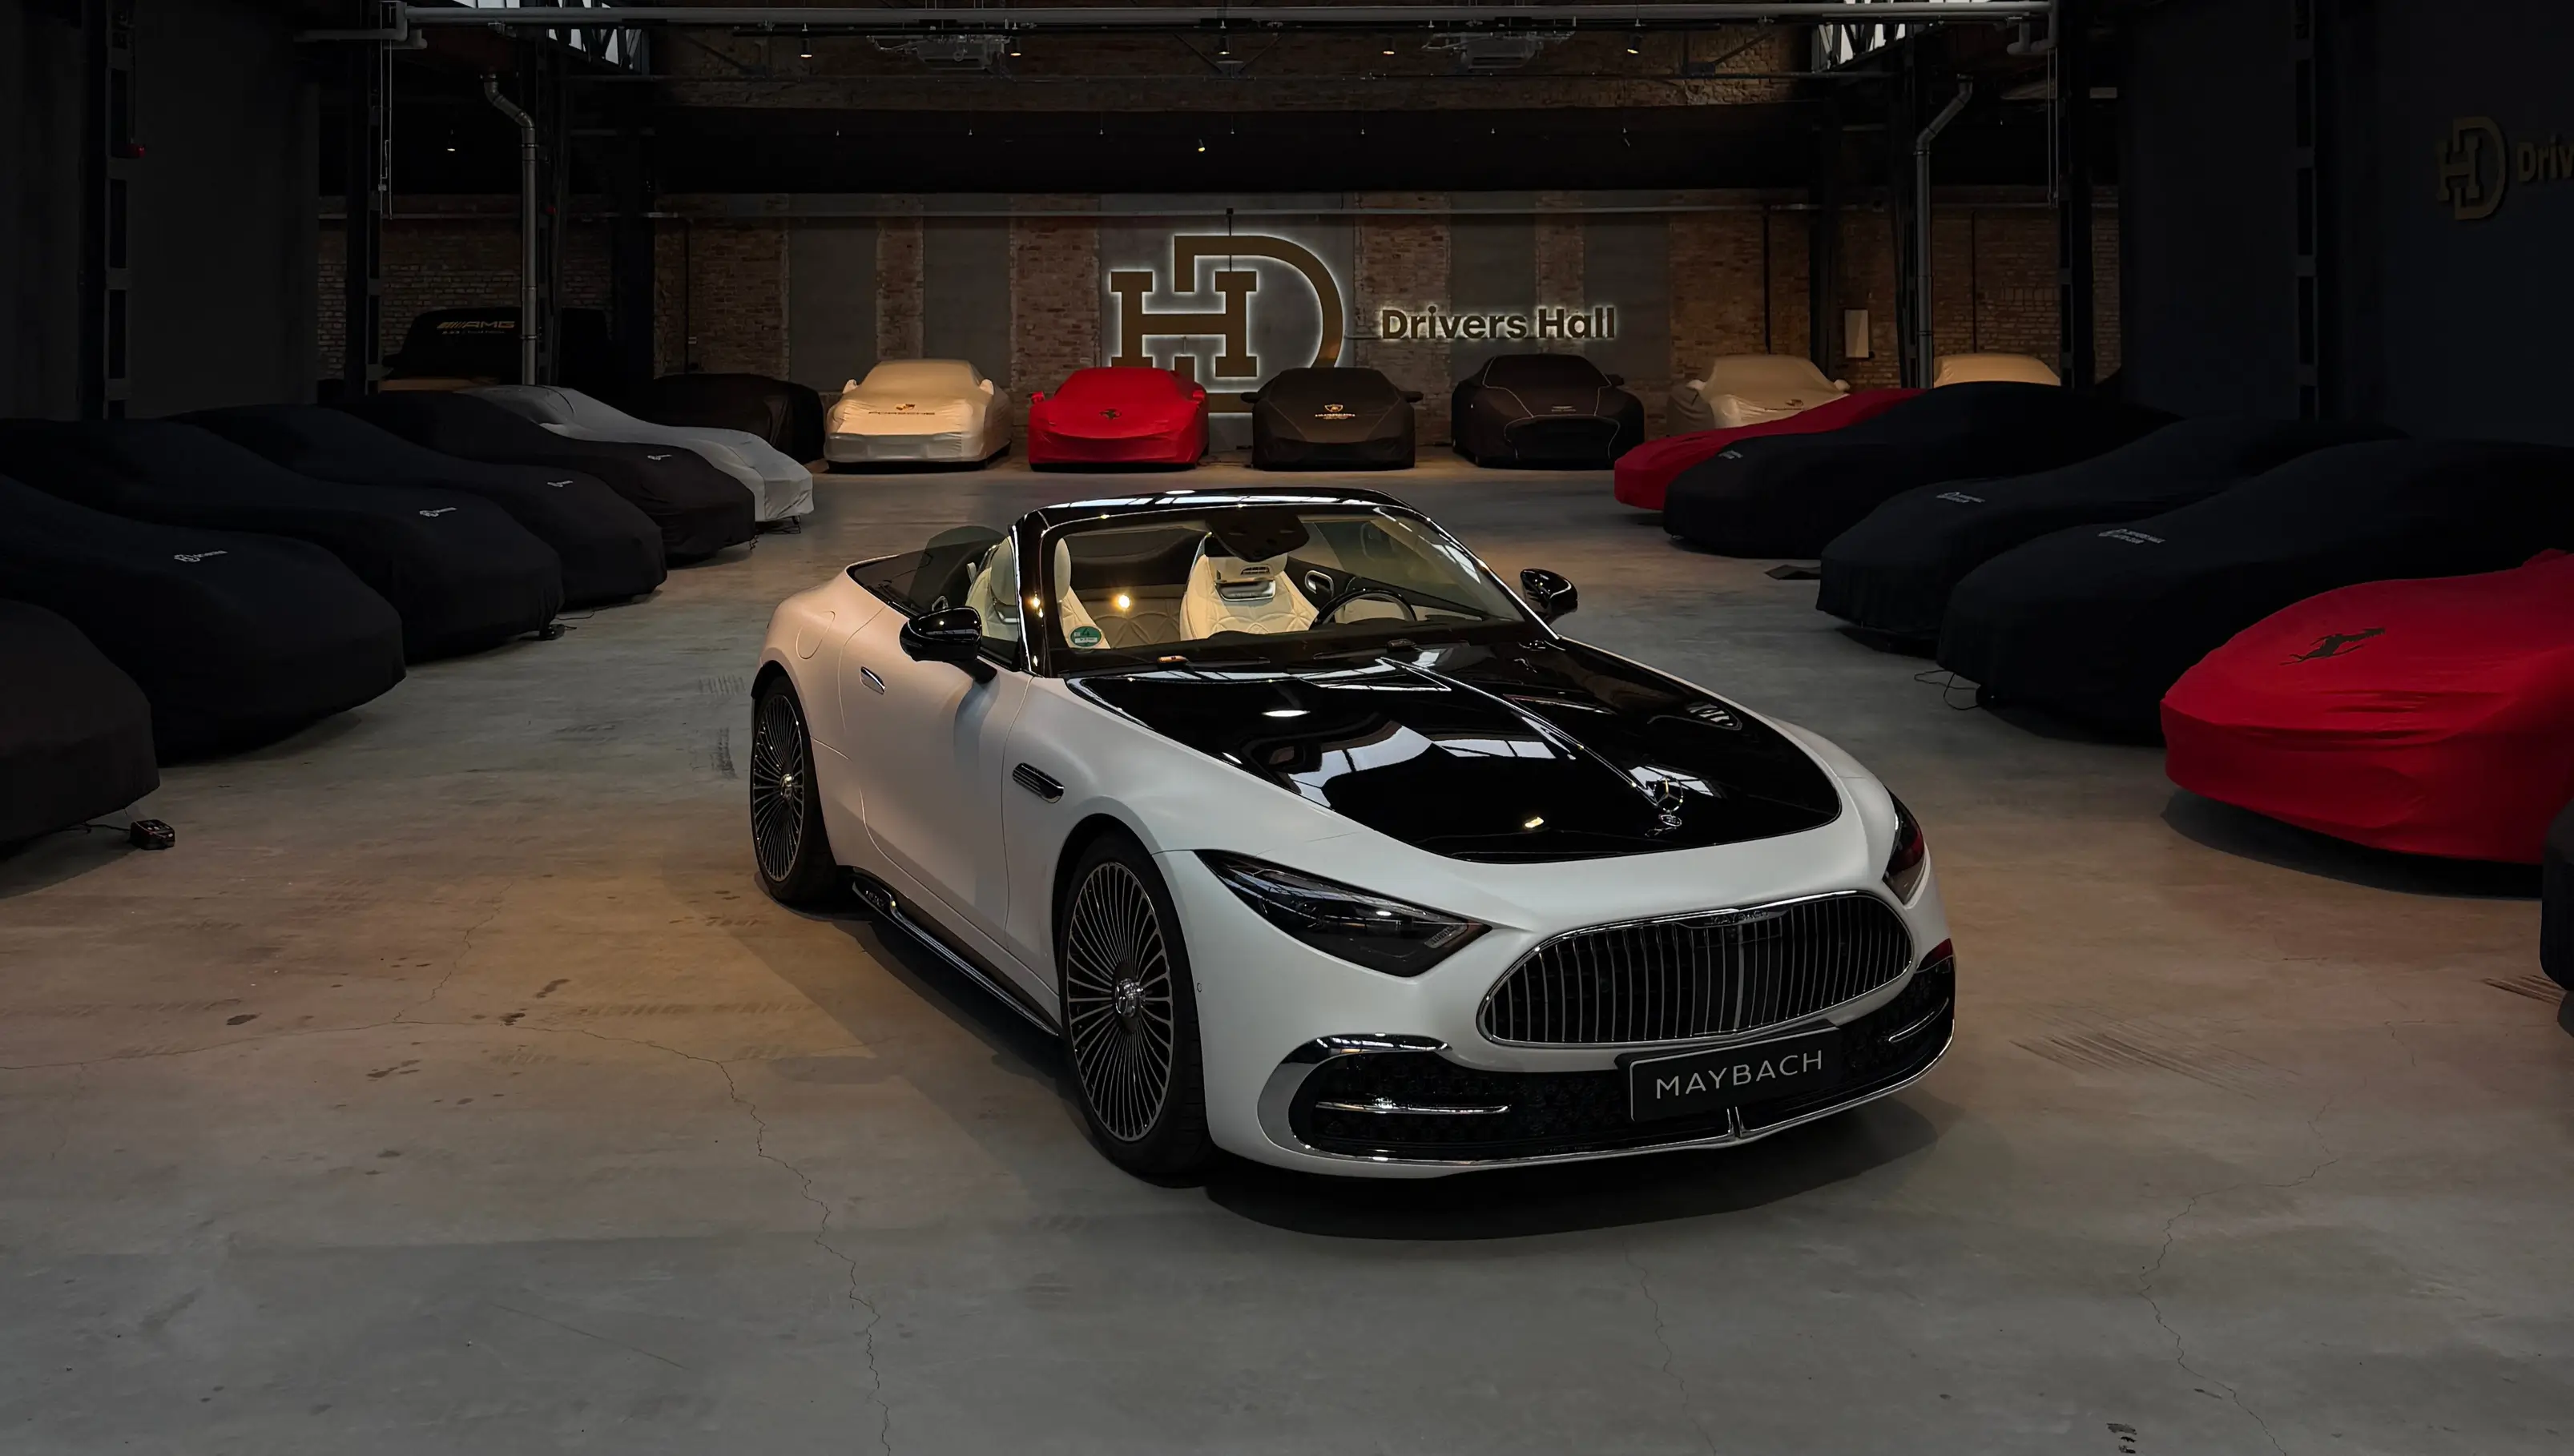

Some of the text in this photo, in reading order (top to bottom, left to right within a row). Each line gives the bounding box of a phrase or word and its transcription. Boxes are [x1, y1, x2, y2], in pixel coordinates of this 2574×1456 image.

[463, 320, 516, 329] AMG
[1382, 305, 1615, 339] Drivers Hall
[1655, 1048, 1823, 1100] MAYBACH
